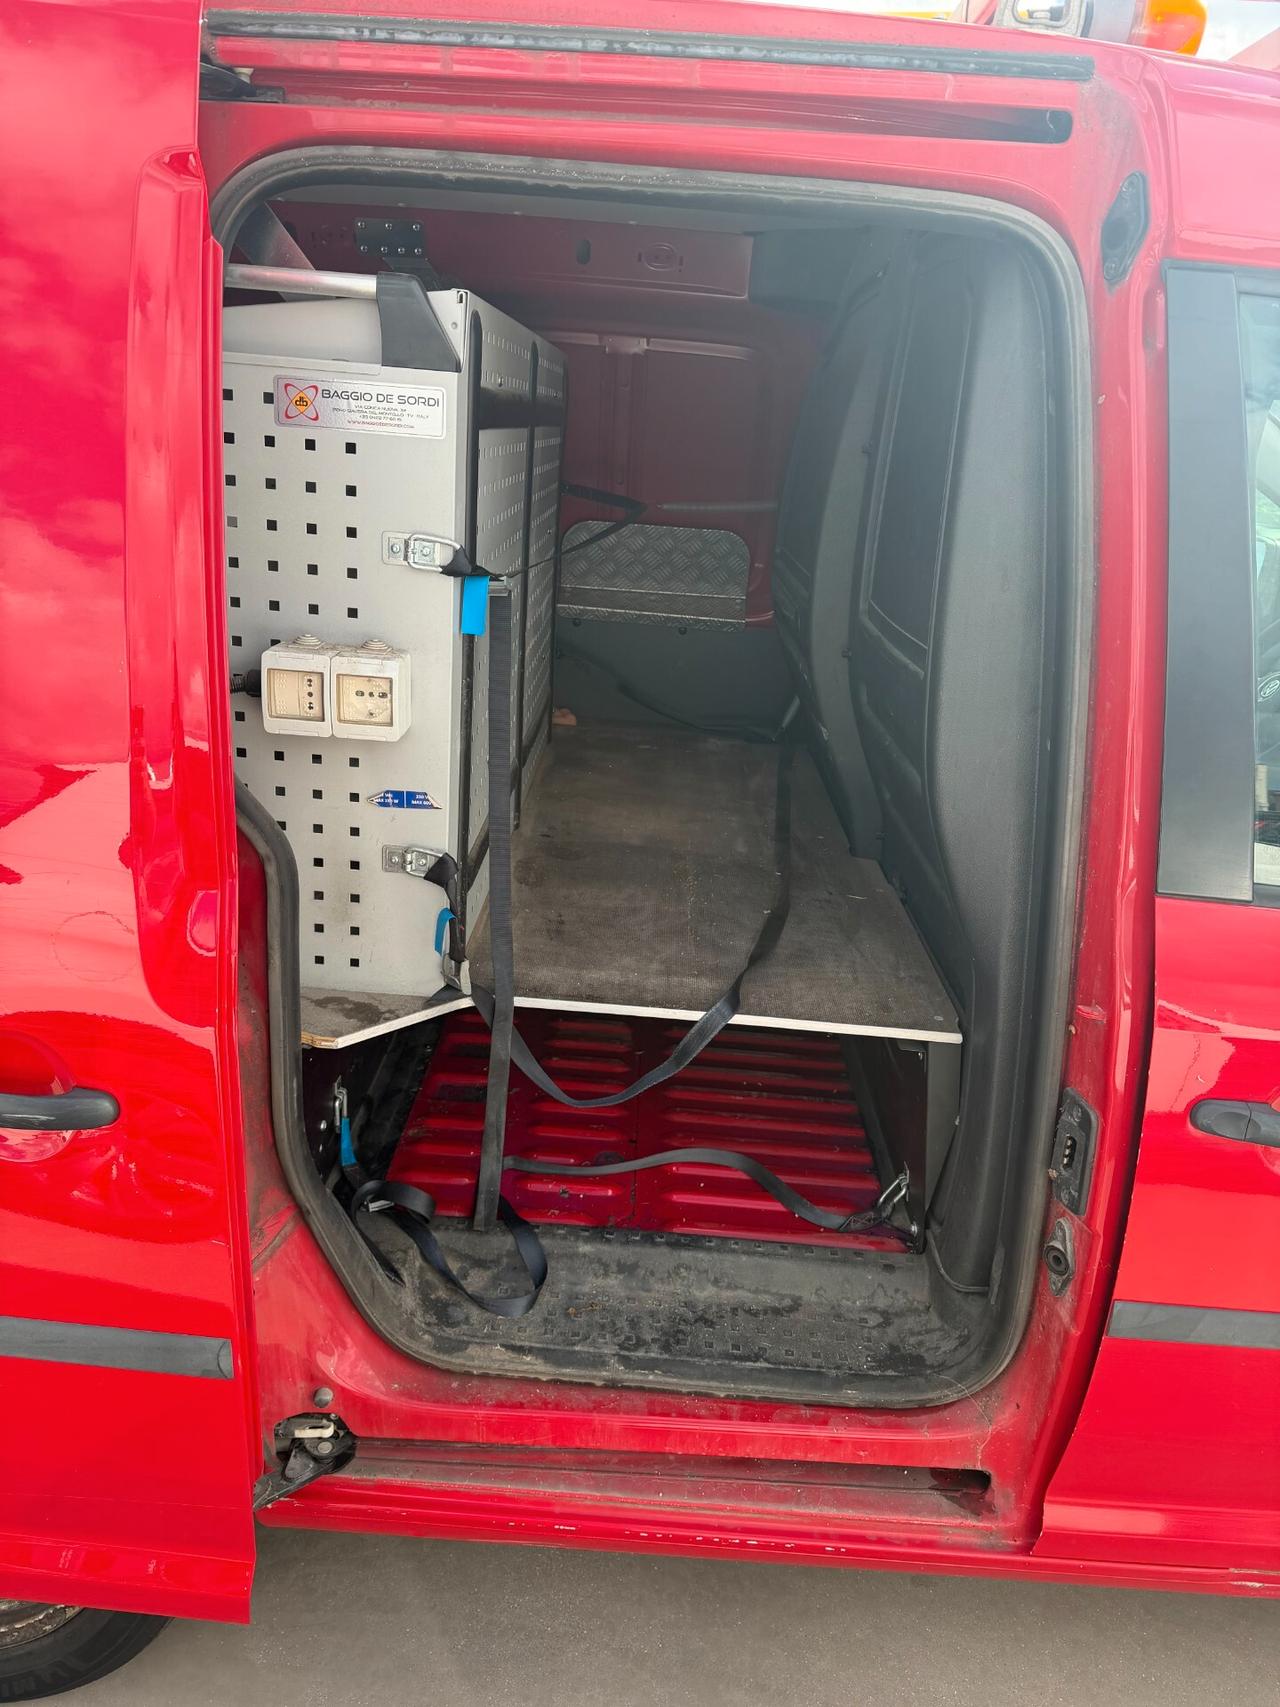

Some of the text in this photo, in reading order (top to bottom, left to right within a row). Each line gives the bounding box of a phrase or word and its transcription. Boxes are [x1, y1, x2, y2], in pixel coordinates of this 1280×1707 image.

[321, 388, 440, 408] BAGGIO DE SORDI
